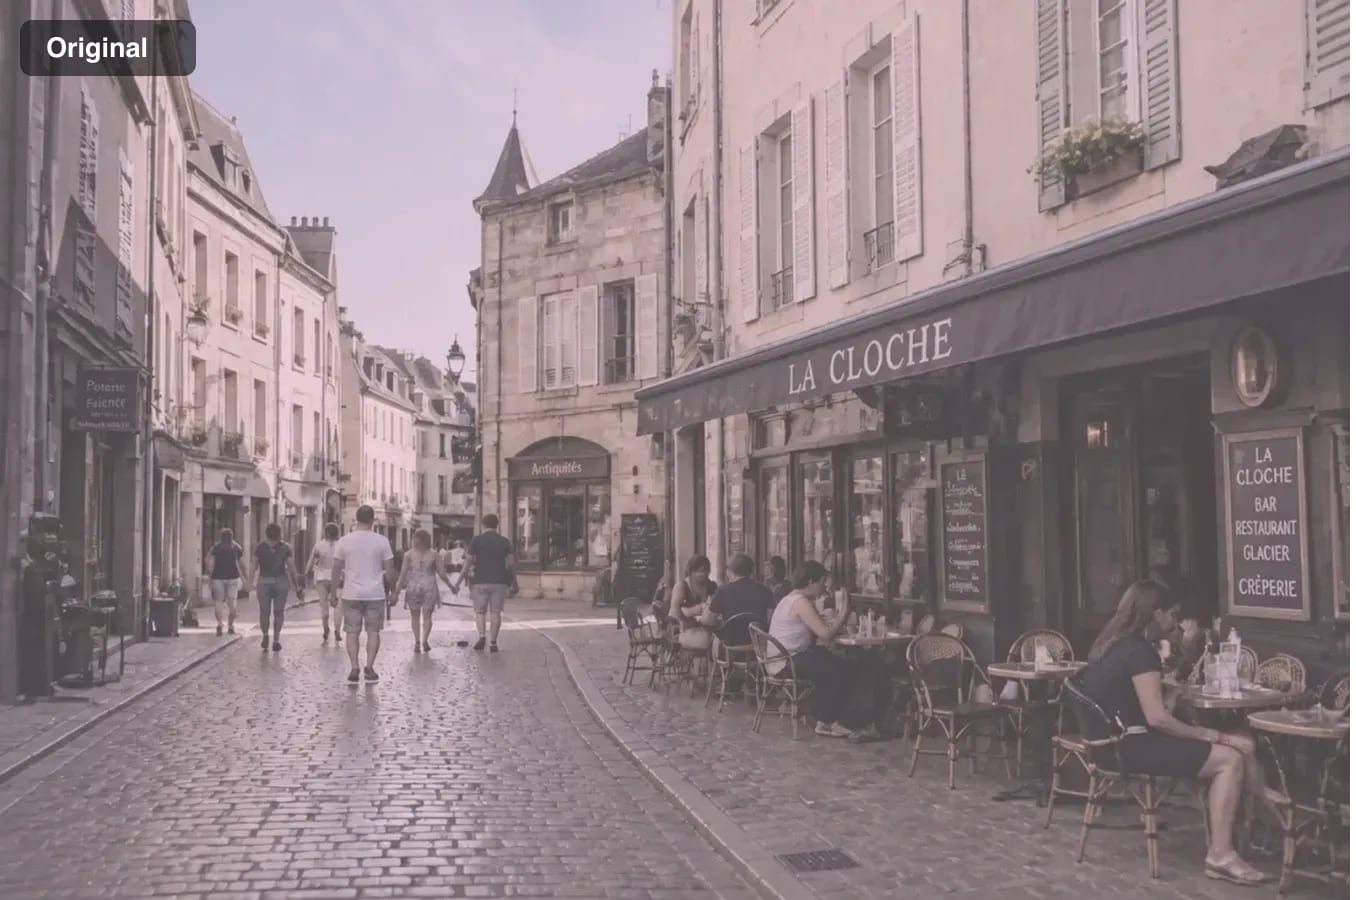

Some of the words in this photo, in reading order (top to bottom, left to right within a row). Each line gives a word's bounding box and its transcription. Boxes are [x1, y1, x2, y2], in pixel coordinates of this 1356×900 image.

[788, 359, 817, 395] LA
[829, 318, 953, 384] CLOCHE
[1255, 447, 1273, 463] LA
[531, 461, 583, 477] Antiquités
[1236, 466, 1293, 485] CLOCHE
[1254, 496, 1277, 512] BAR
[1235, 520, 1297, 535] RESTAURANT
[1243, 544, 1290, 561] GLACIER
